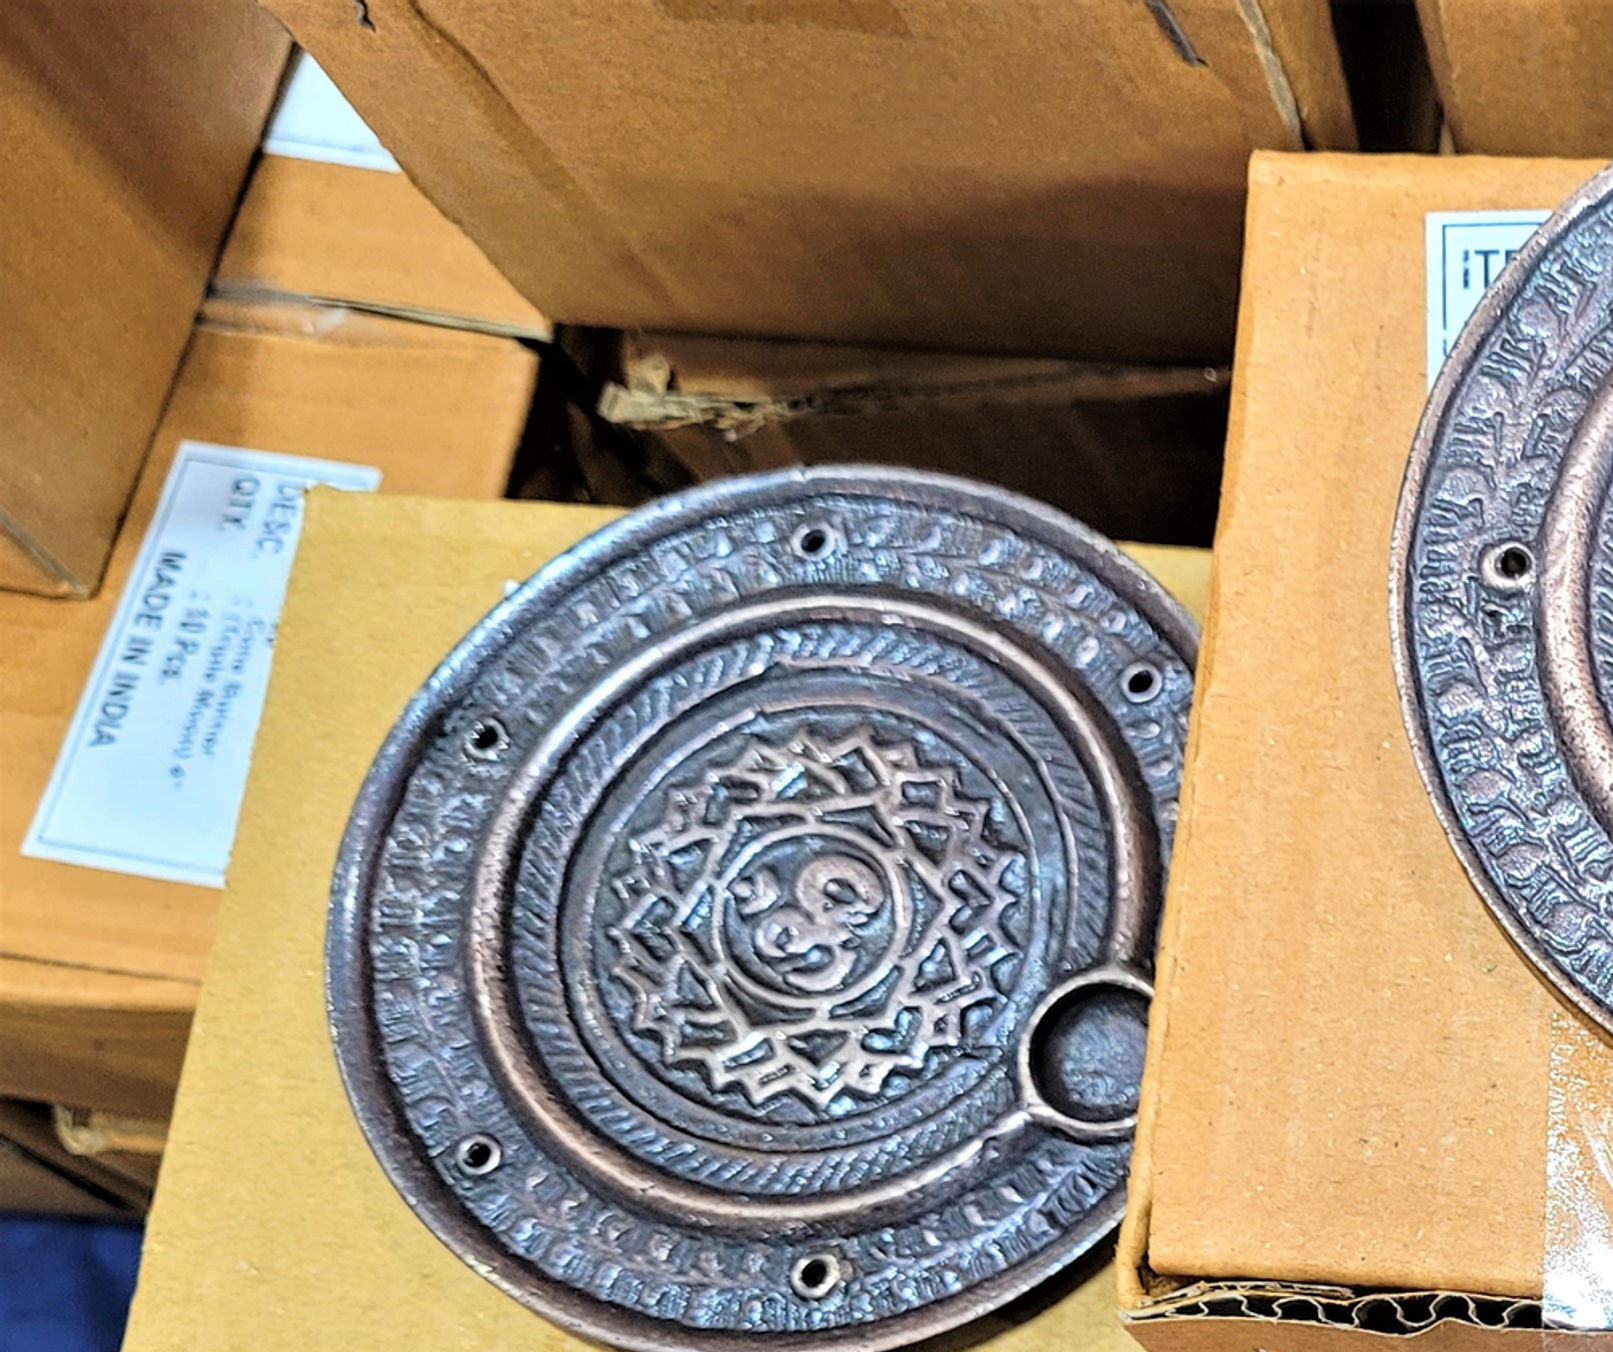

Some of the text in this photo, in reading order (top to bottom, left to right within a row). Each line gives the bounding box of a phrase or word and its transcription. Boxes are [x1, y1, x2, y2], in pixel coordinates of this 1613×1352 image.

[87, 551, 188, 747] MADE IN INDIA
